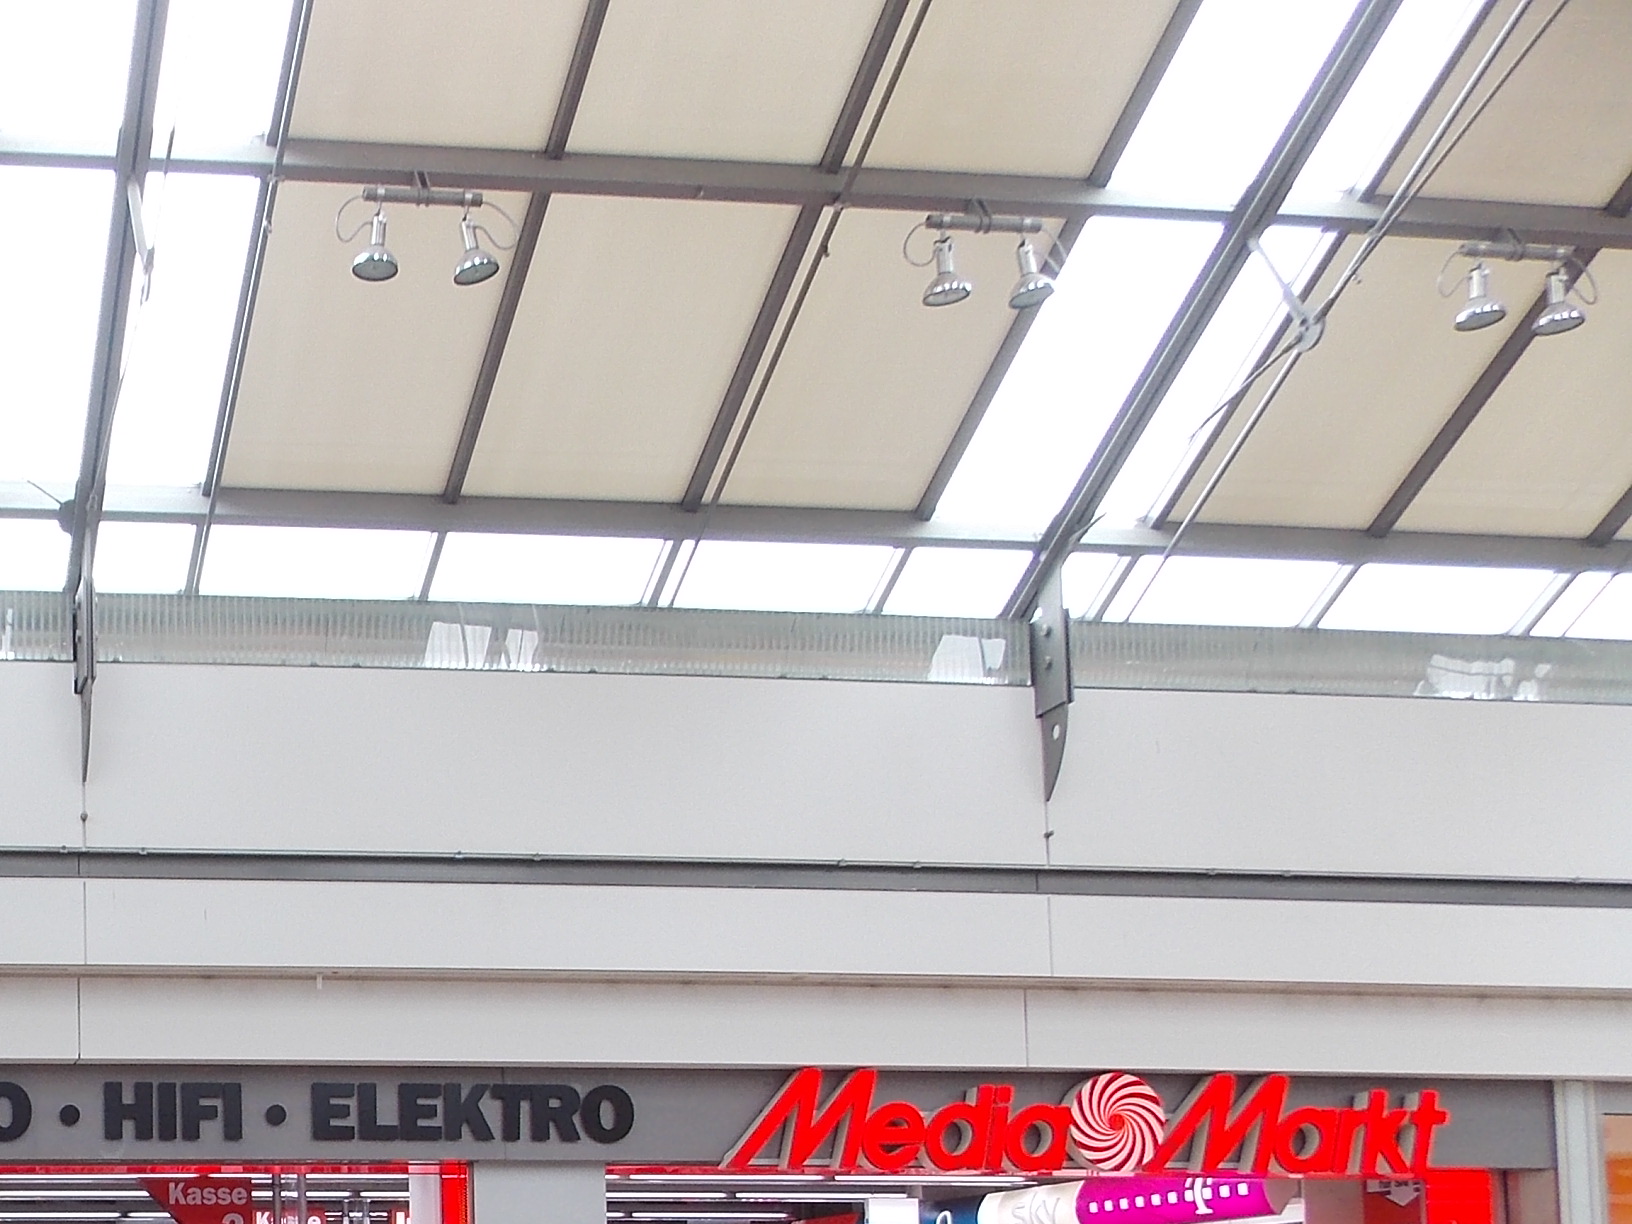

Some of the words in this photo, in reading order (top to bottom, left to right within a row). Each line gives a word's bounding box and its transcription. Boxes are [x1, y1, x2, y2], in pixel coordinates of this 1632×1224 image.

[102, 1082, 242, 1141] HIFI
[310, 1082, 635, 1143] ELEKTRO
[720, 1067, 1074, 1171] Media
[1140, 1074, 1449, 1174] Markt
[168, 1181, 248, 1206] Kasse
